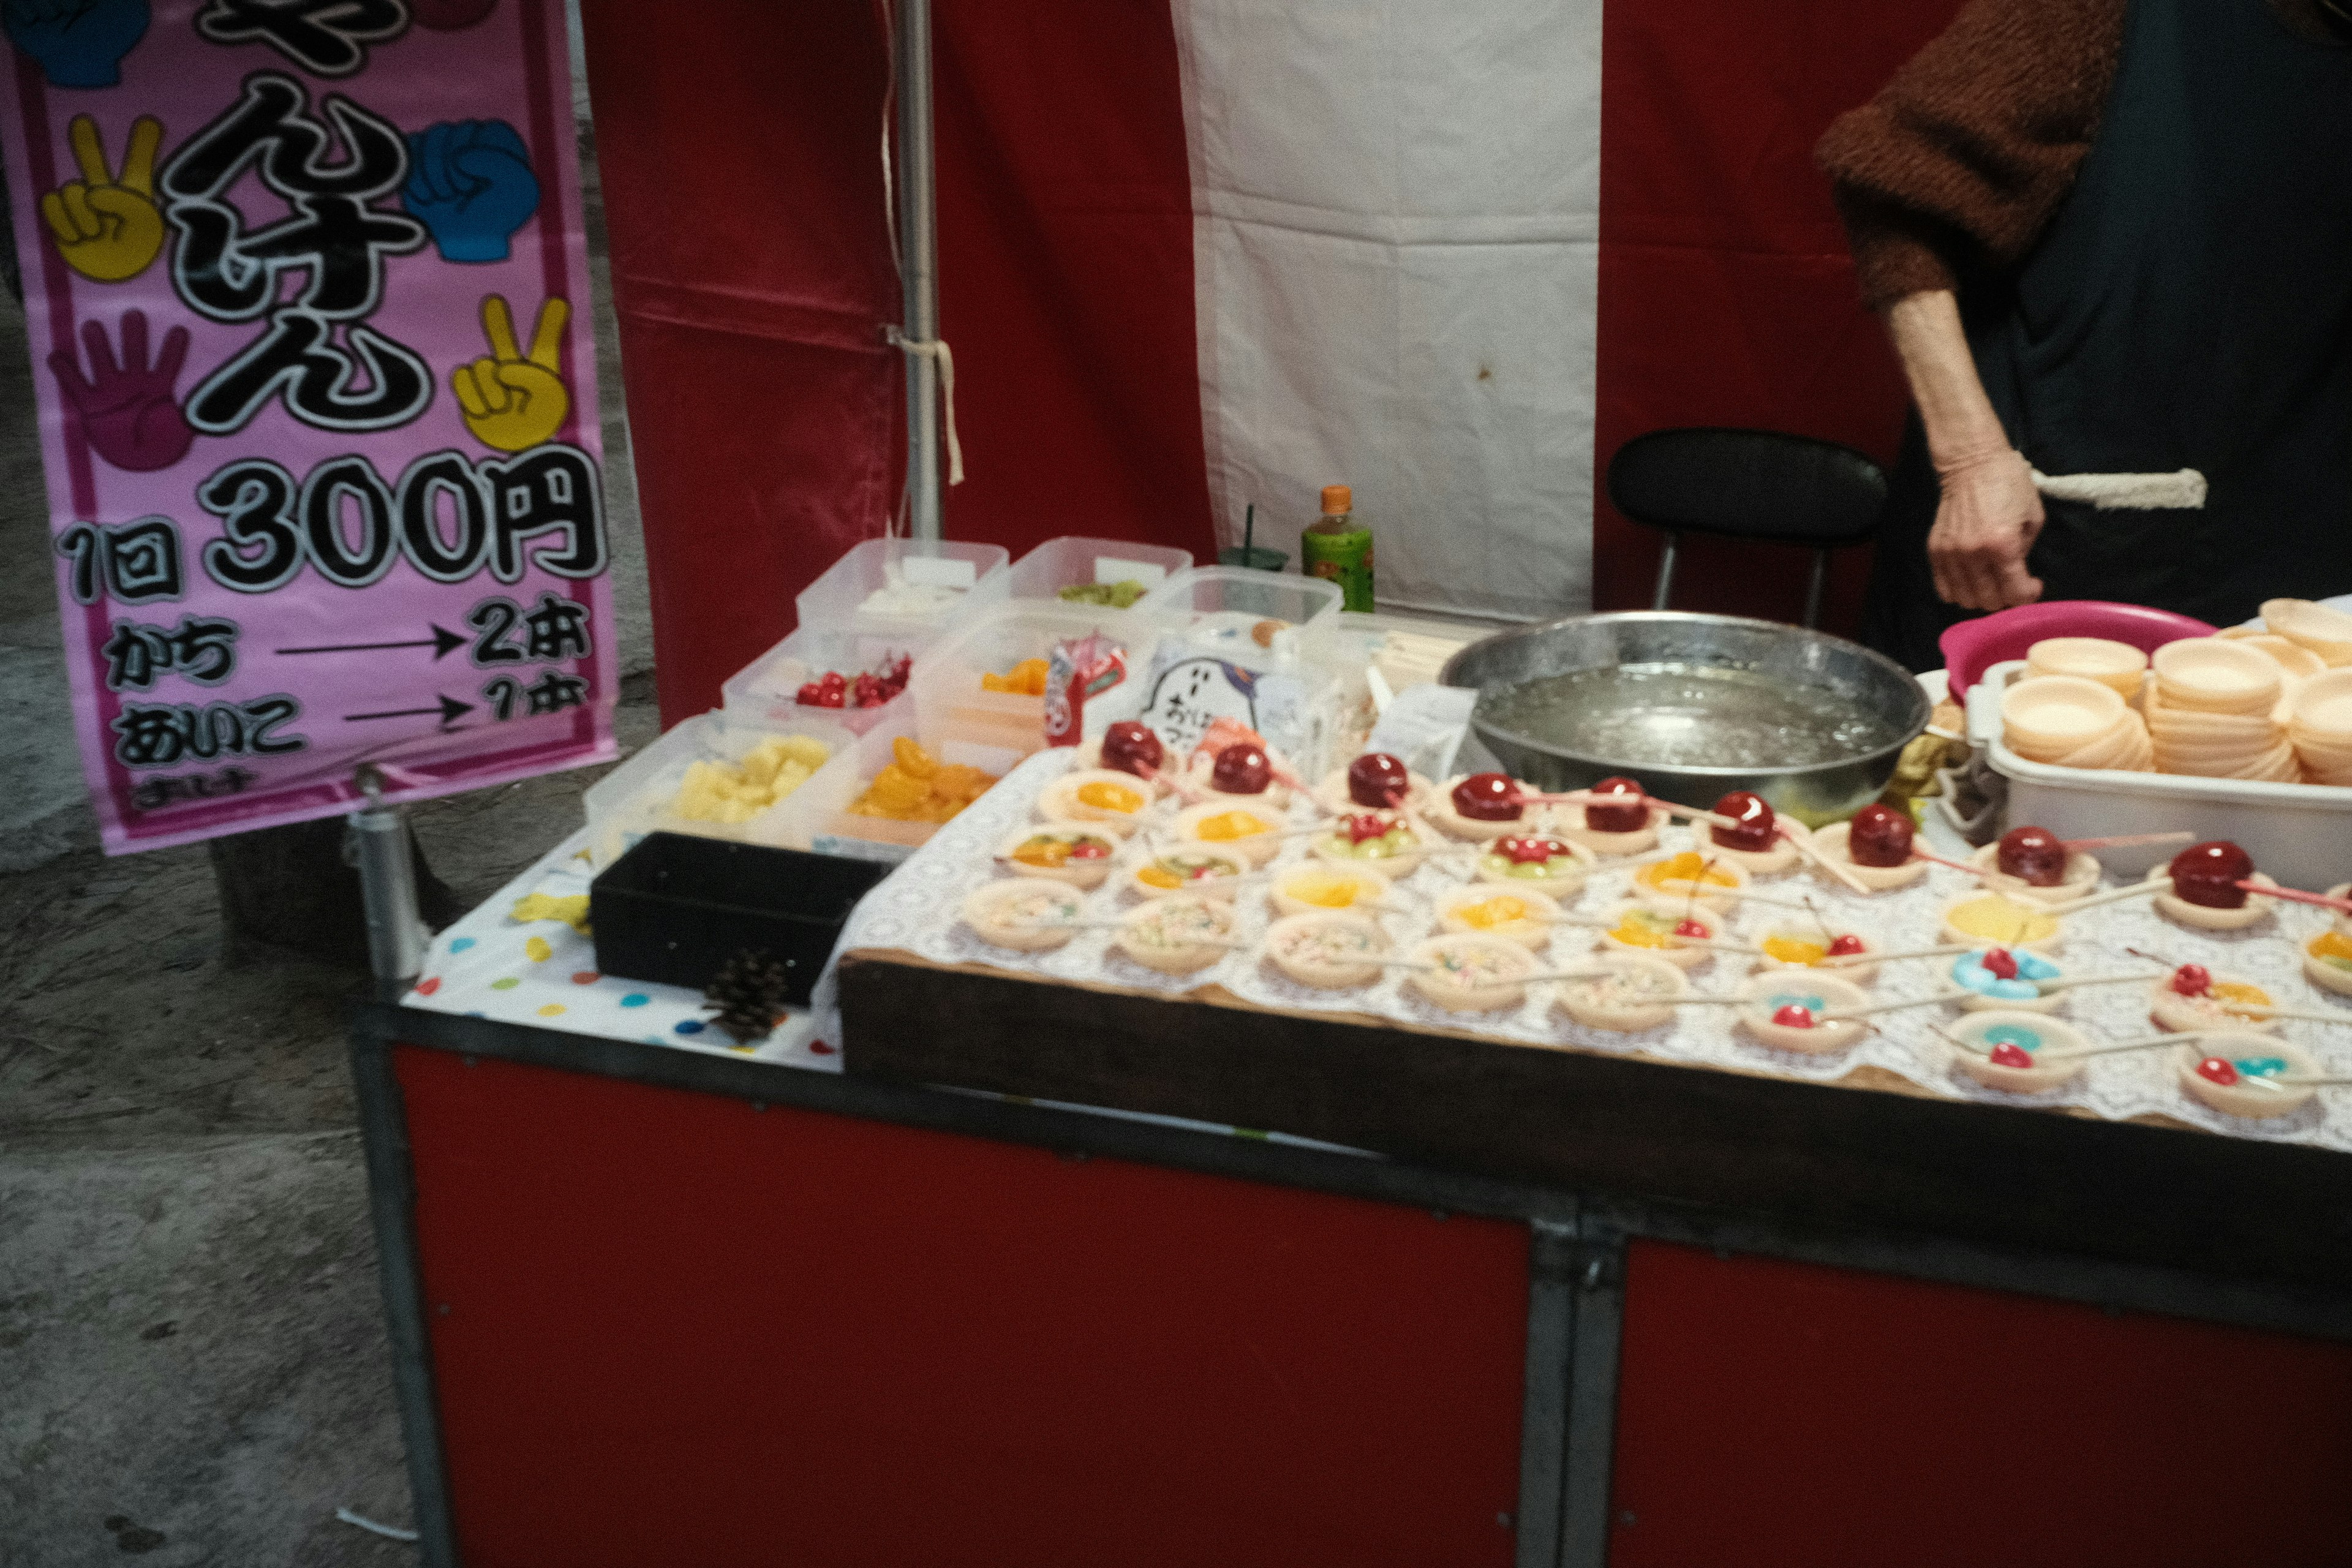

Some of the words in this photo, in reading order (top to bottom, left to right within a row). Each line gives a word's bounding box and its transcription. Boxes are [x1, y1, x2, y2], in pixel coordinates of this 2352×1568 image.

[197, 445, 609, 593] 300円
[104, 614, 238, 690] かち
[468, 592, 592, 668] 2本
[113, 693, 307, 769] あいこ
